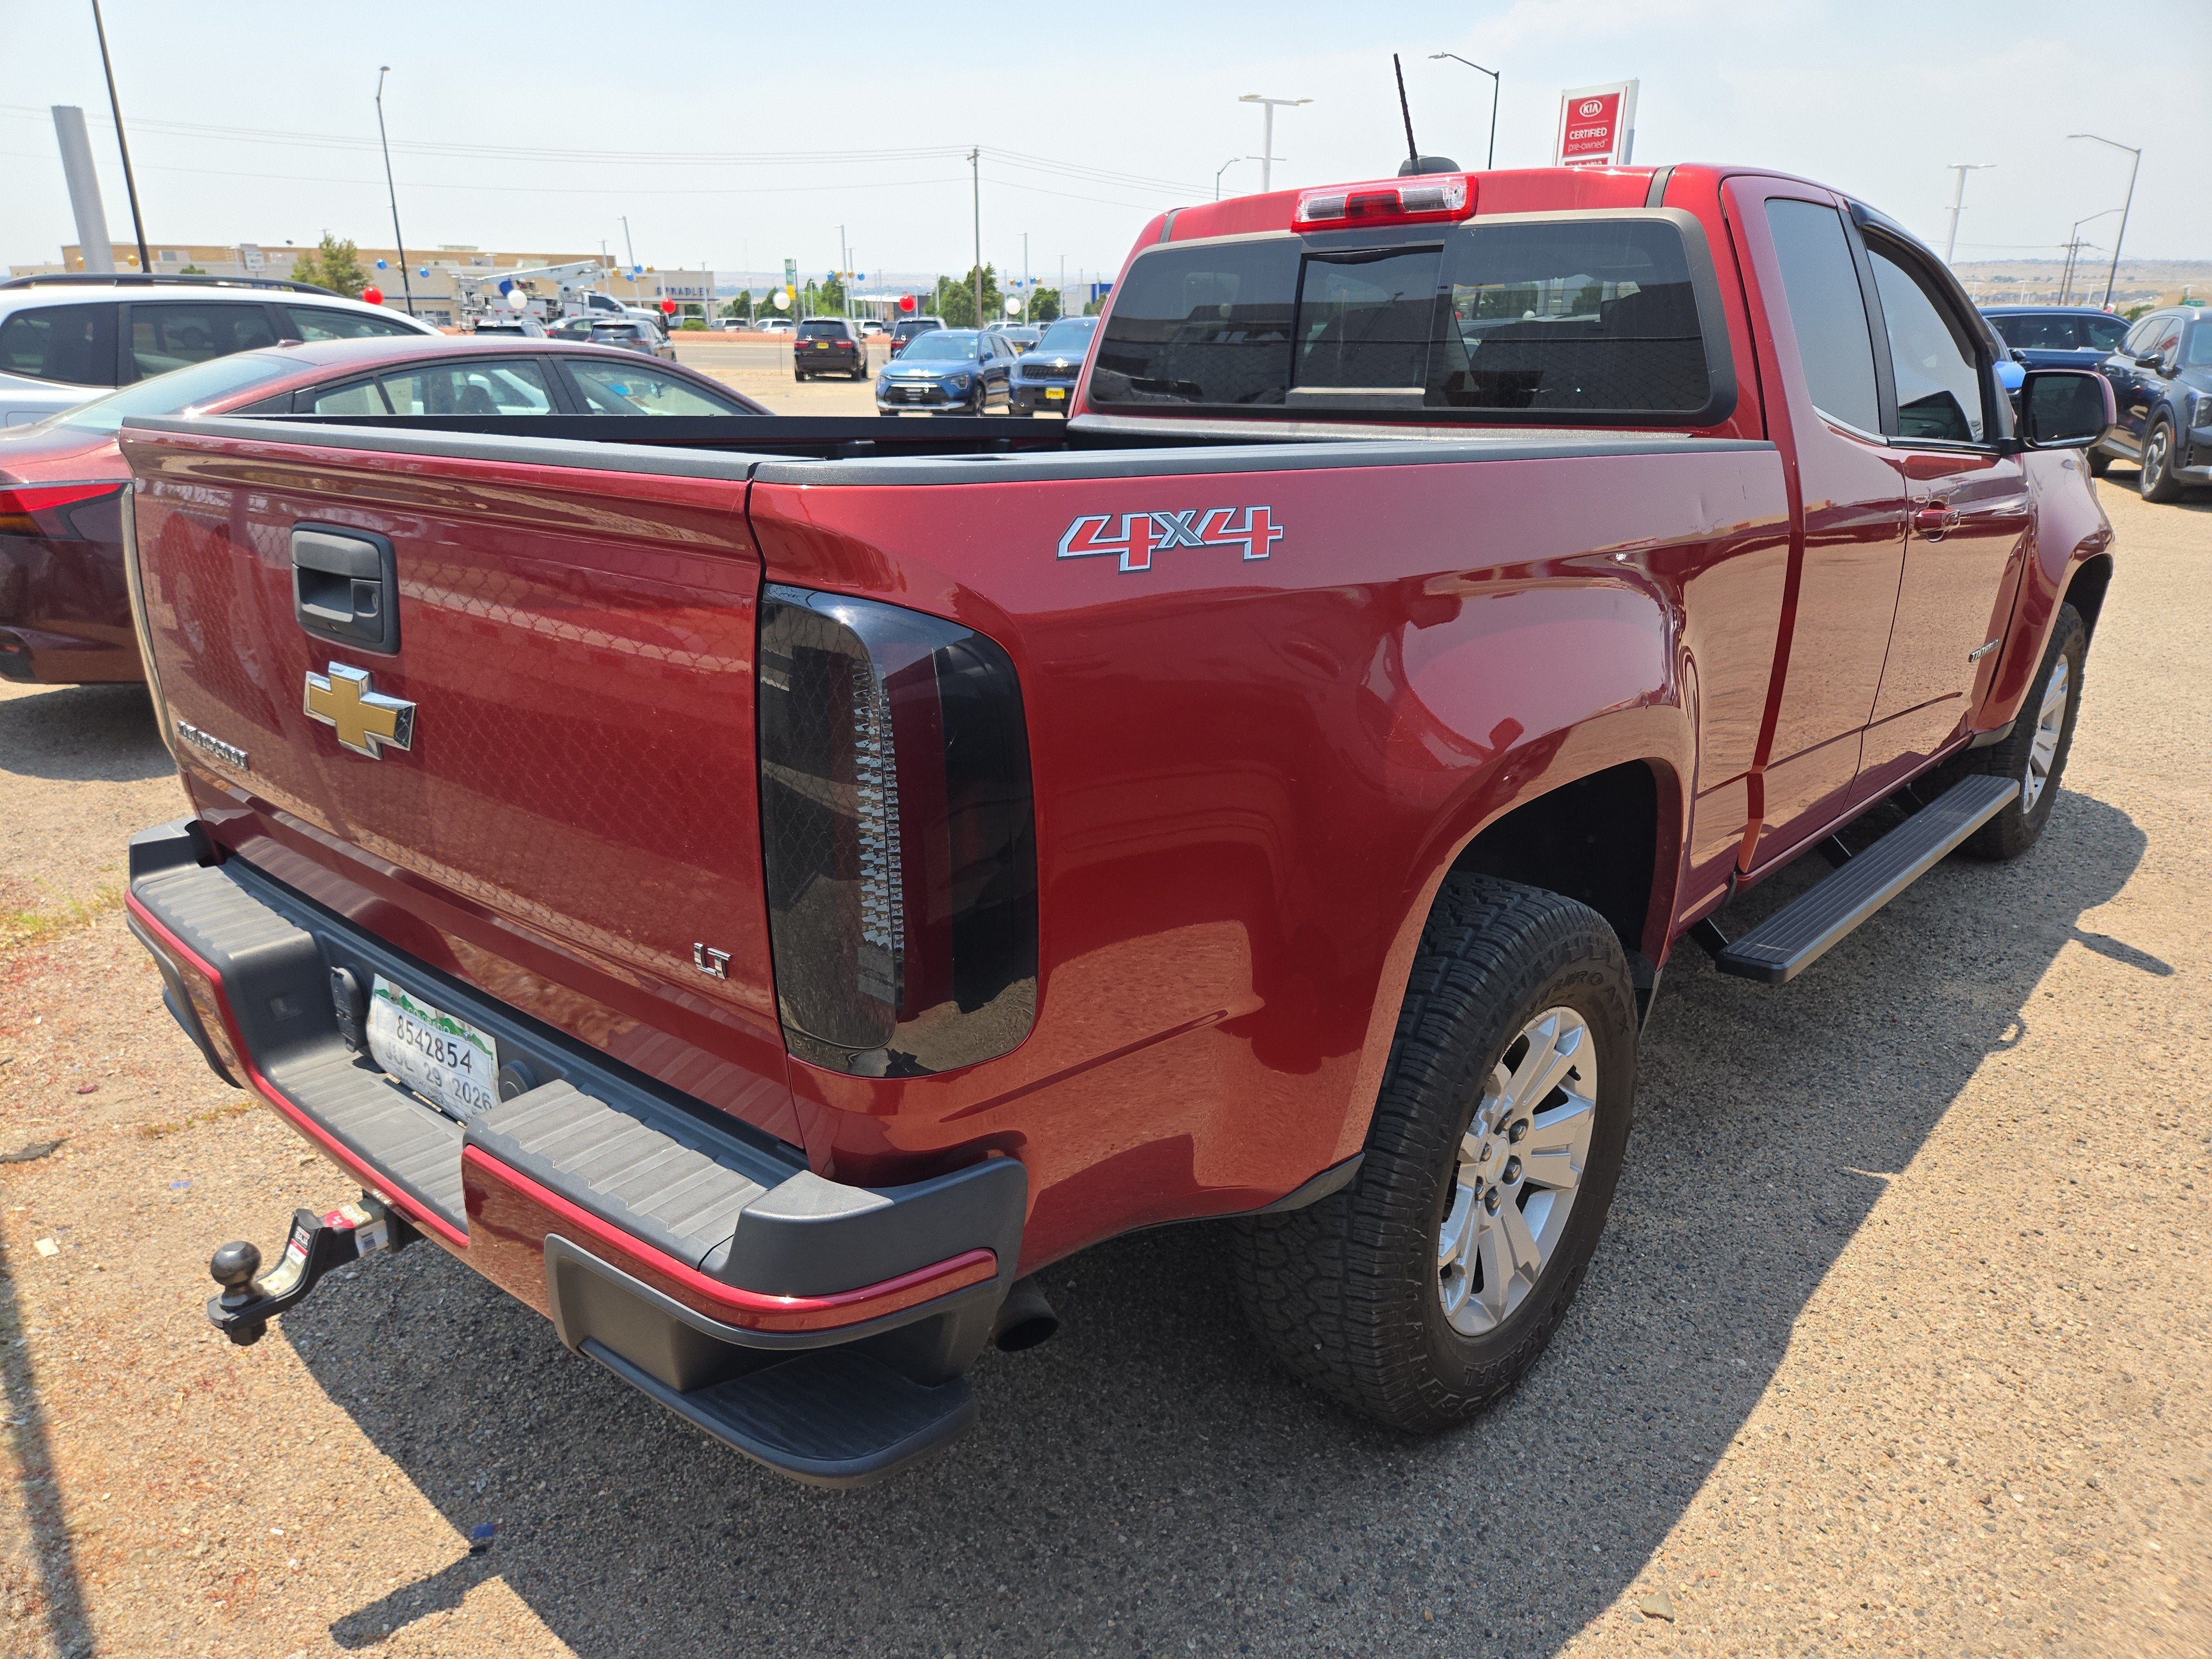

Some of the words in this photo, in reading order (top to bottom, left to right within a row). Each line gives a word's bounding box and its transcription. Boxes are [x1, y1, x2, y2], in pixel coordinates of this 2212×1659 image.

[1583, 104, 1599, 114] KIA
[1570, 127, 1607, 139] CERTIFIED
[1568, 140, 1605, 152] pre-owned
[694, 942, 732, 980] LT
[396, 1015, 472, 1074] 8542854
[423, 1062, 443, 1088] 29
[452, 1077, 493, 1110] 2026
